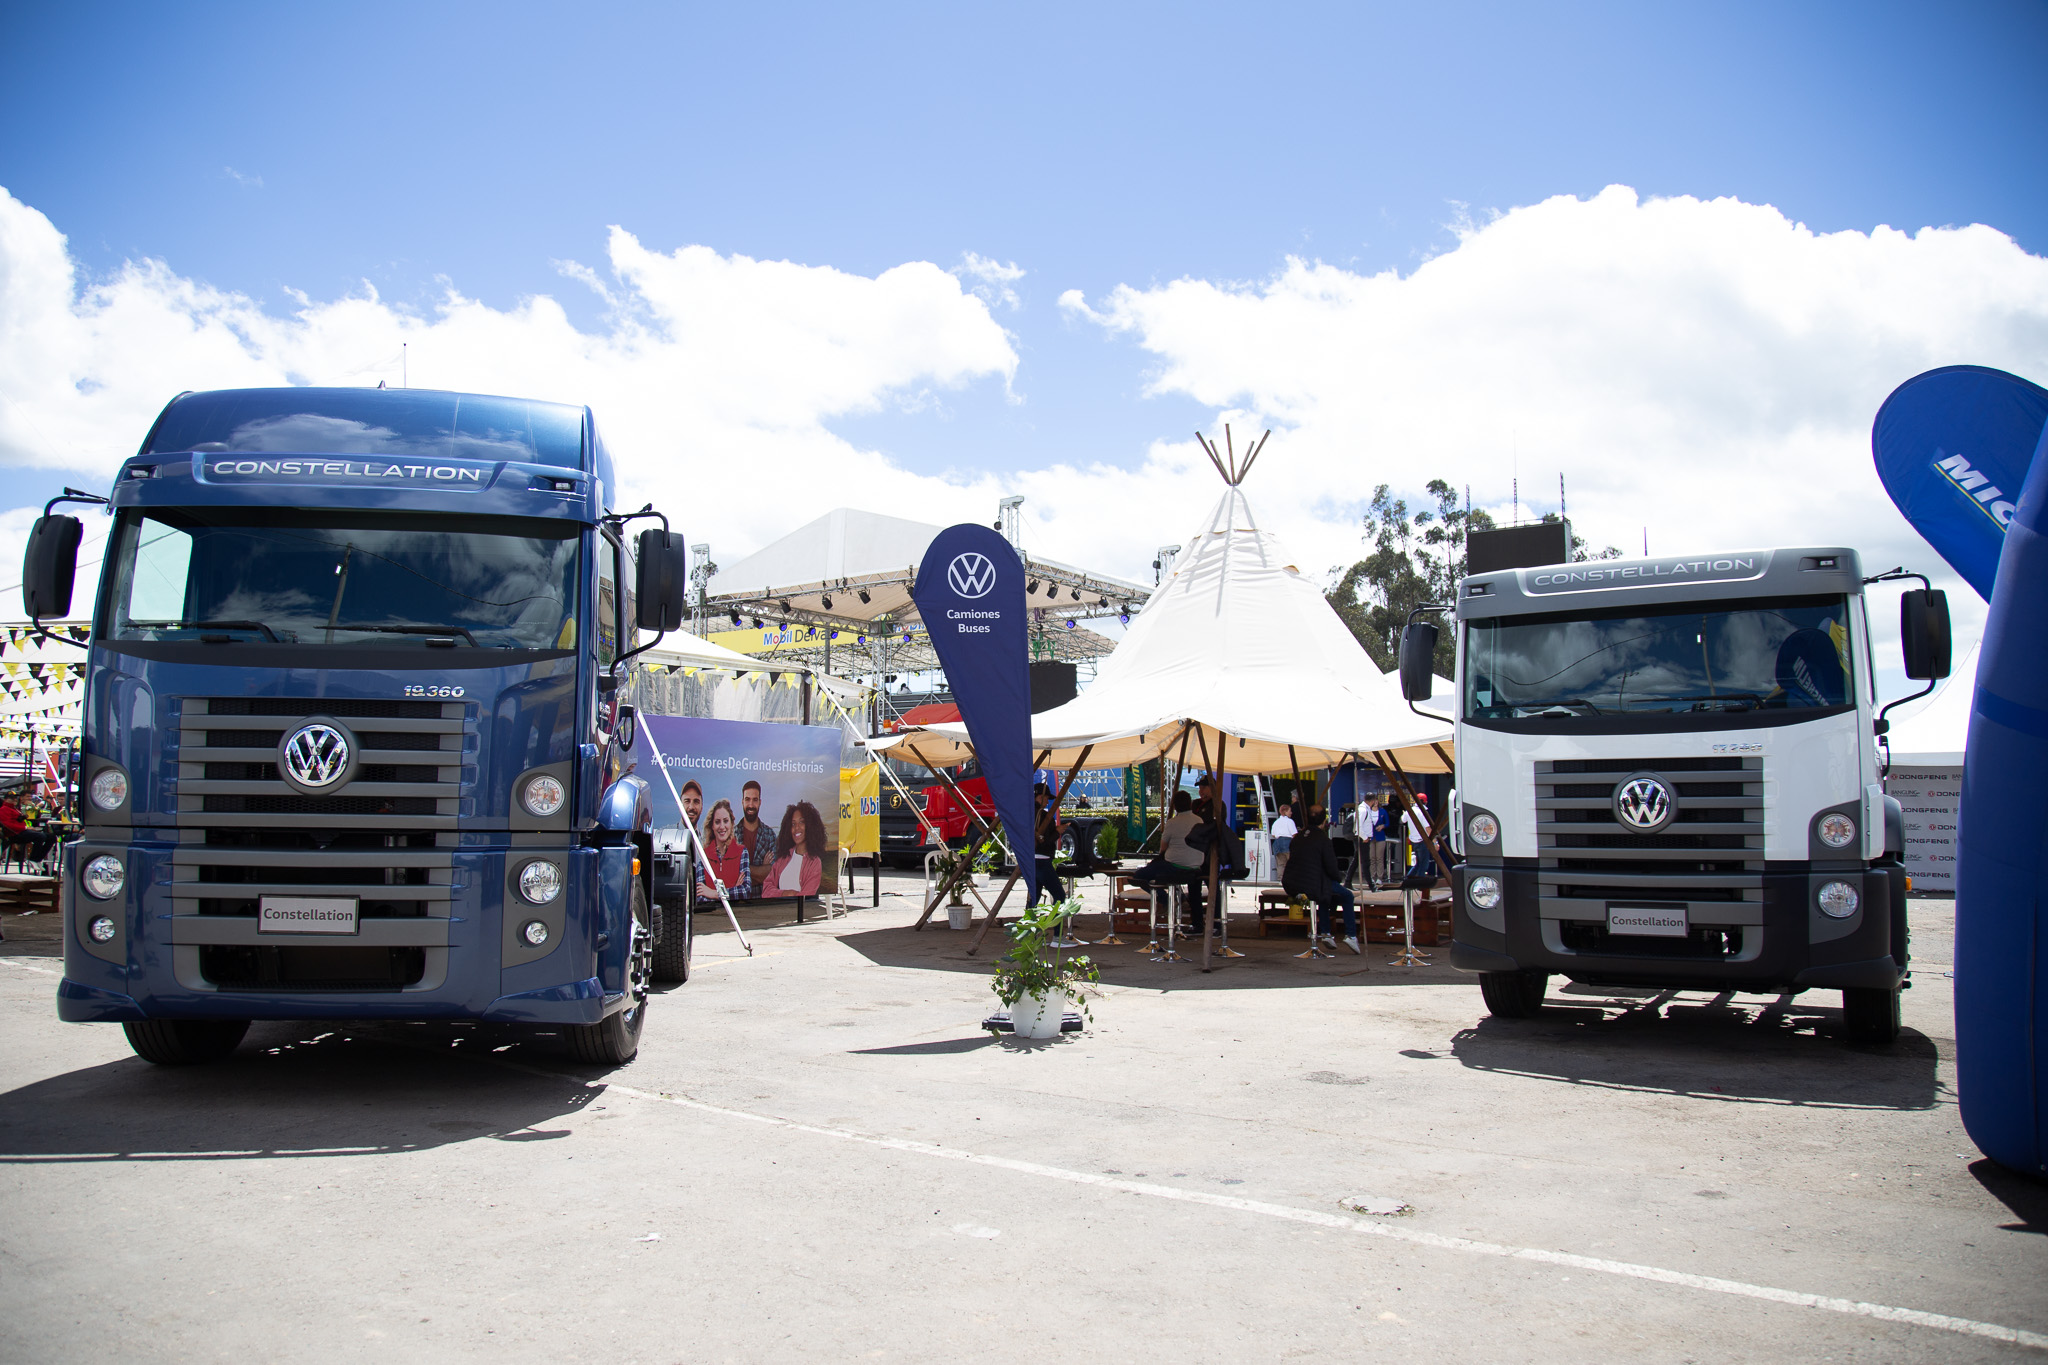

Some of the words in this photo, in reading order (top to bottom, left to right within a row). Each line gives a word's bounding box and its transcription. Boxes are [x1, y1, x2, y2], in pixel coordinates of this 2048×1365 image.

[213, 461, 481, 481] CONSTELLATION
[1534, 558, 1754, 586] CONSTELLATION
[946, 609, 1001, 619] Camiones
[958, 623, 991, 633] Buses
[763, 630, 793, 646] Mobil
[651, 753, 824, 774] #ConductoresDeGrandesHistorias
[263, 908, 353, 921] Constellation
[1611, 916, 1684, 927] Constellation
